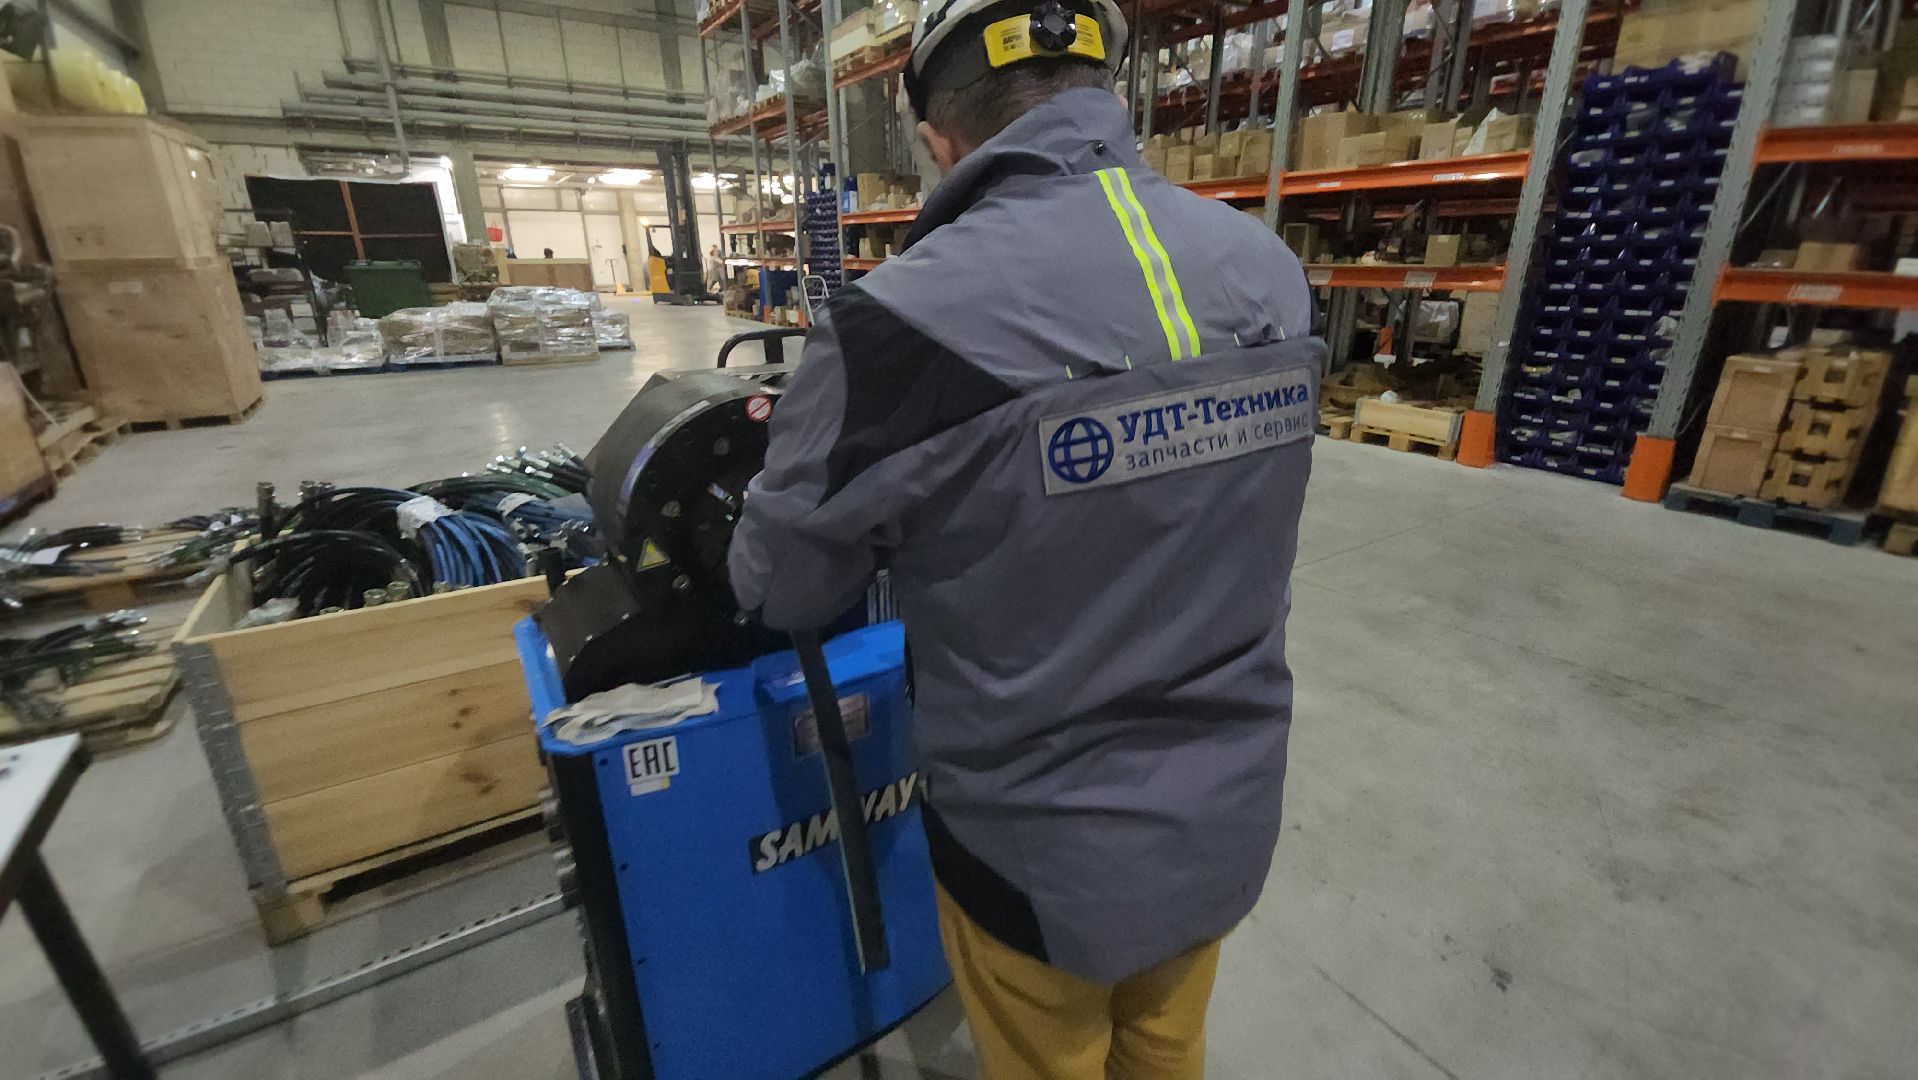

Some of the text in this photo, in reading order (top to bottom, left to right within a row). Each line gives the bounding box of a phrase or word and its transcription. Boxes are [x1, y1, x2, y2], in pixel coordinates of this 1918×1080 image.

[1117, 383, 1310, 445] УДТ-Техника
[1125, 413, 1309, 471] запчасти и сервис
[628, 740, 677, 779] EAC
